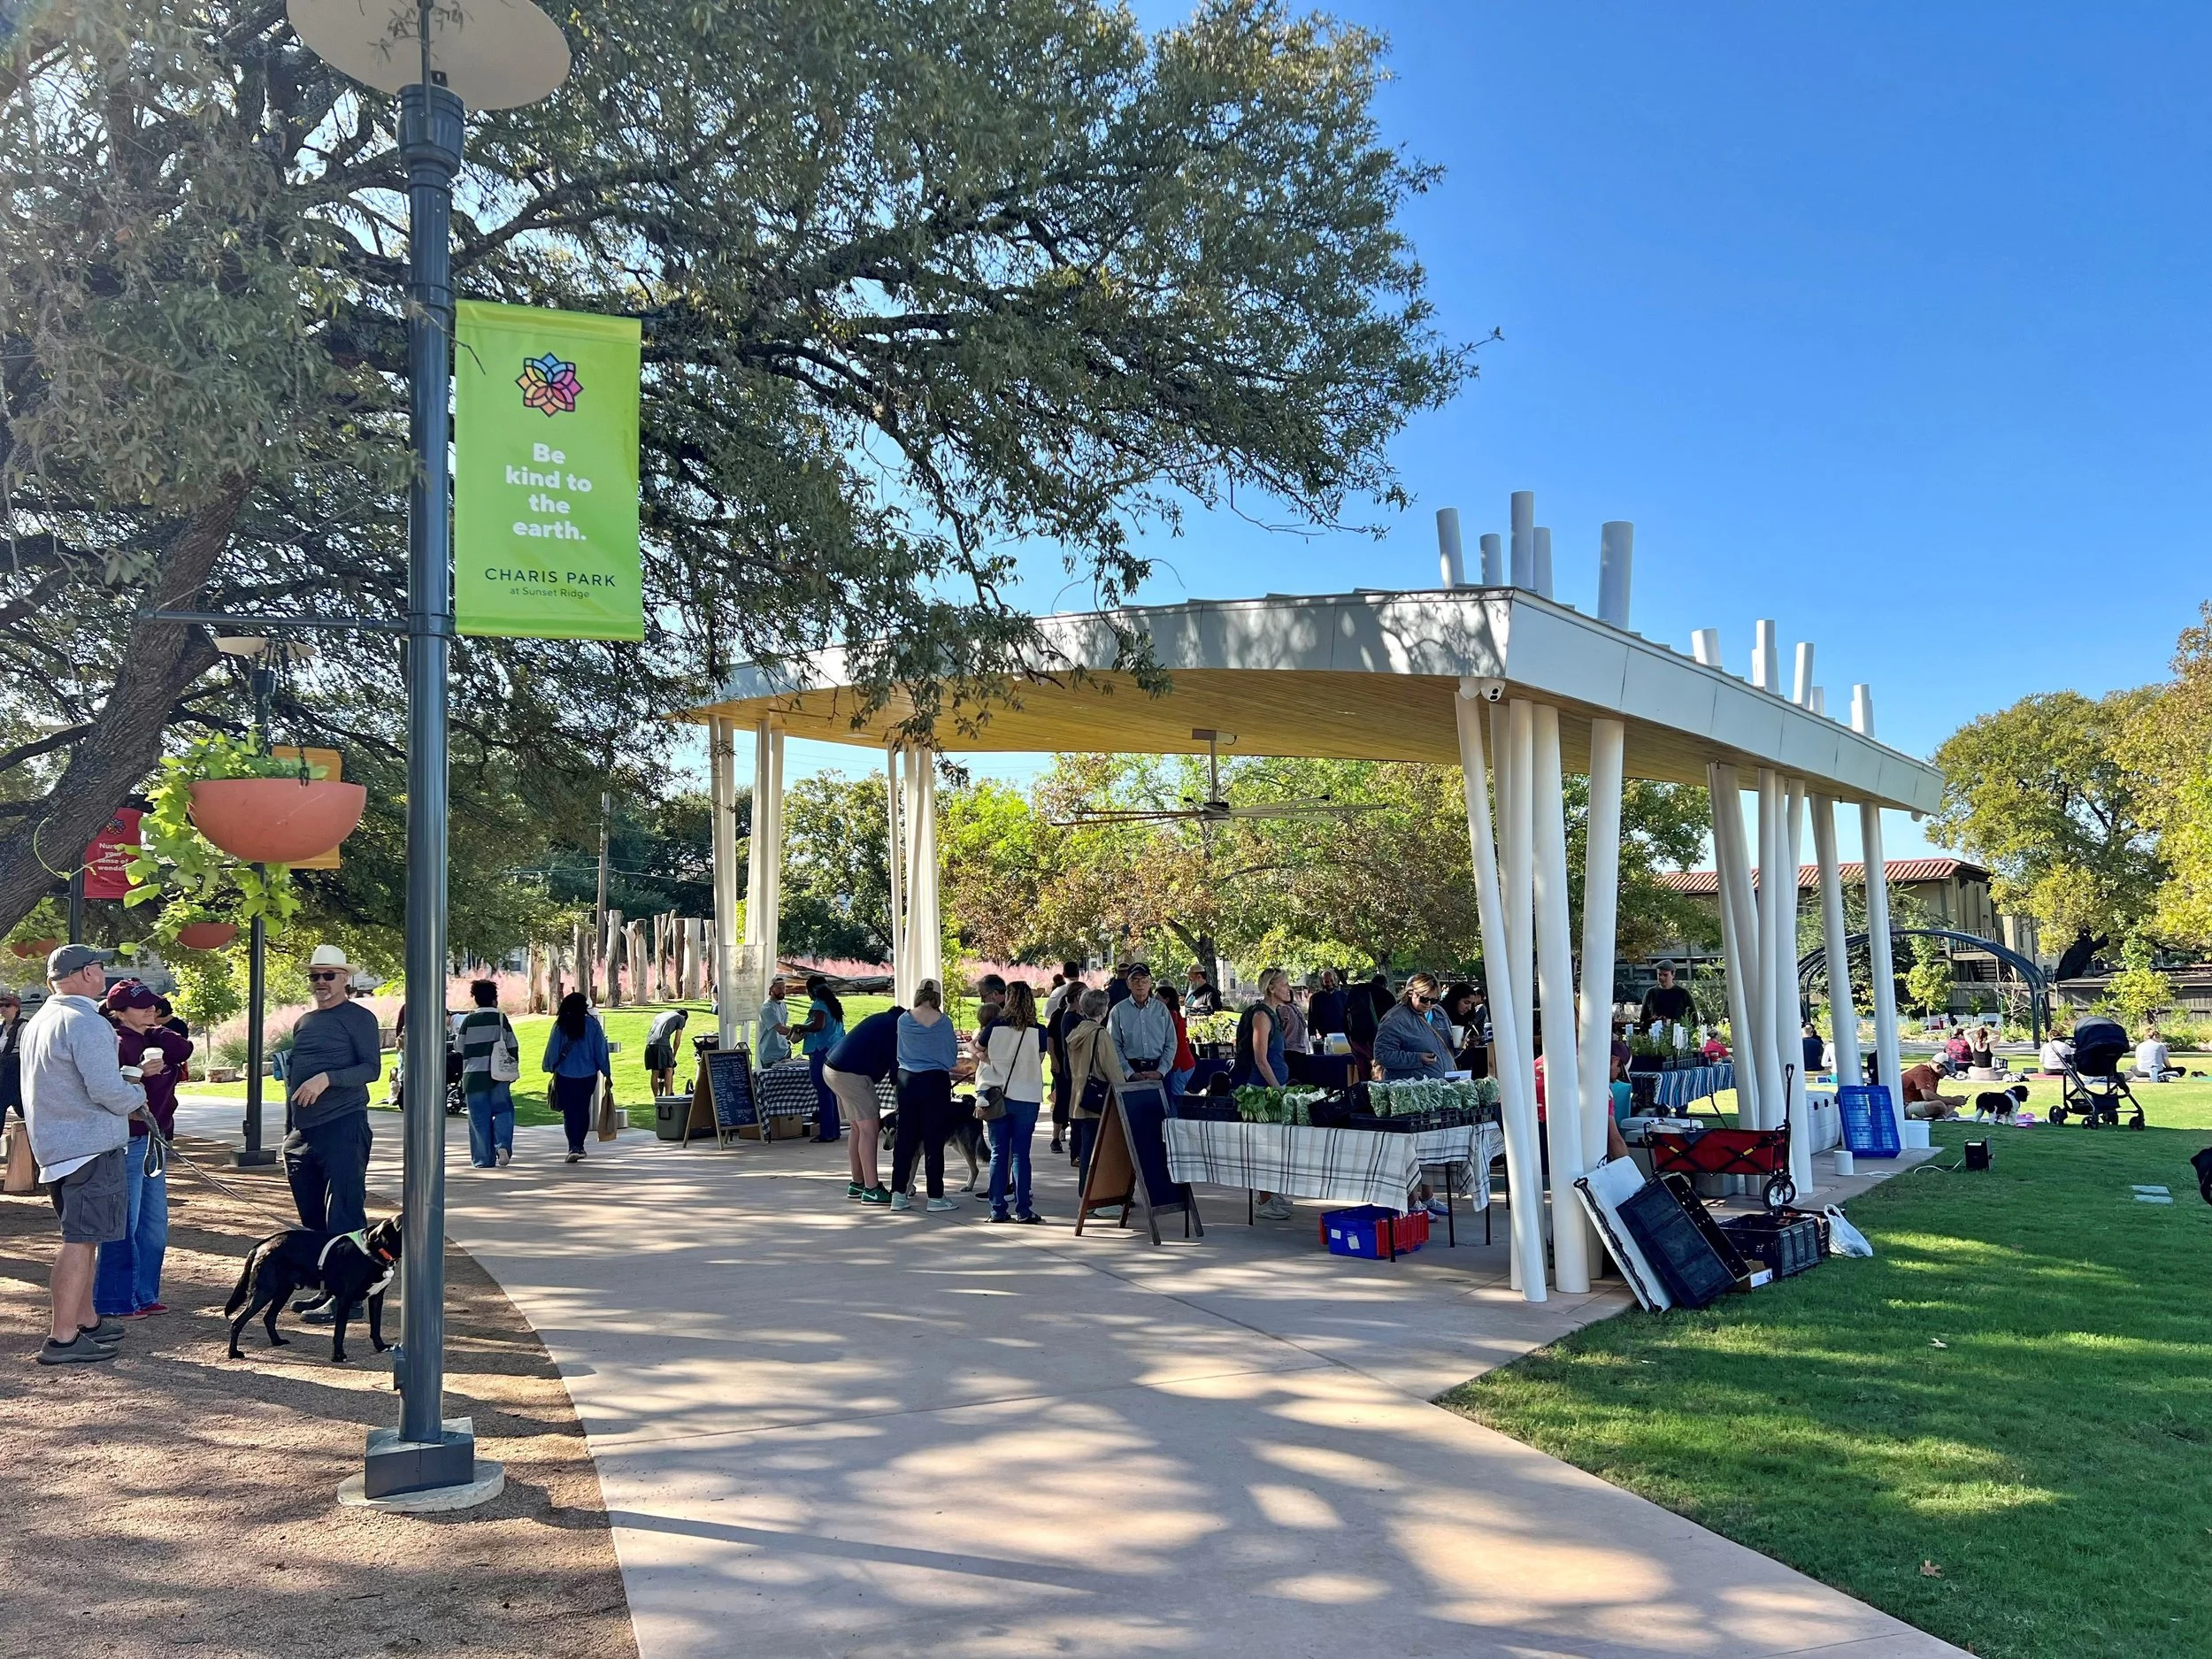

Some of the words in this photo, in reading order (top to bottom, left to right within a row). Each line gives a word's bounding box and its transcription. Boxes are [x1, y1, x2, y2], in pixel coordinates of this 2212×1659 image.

[534, 442, 566, 465] Be
[505, 465, 561, 489] kind
[566, 473, 593, 493] to
[528, 493, 571, 514] the
[512, 520, 588, 541] earth.
[485, 568, 558, 583] CHARIS
[567, 572, 616, 588] PARK
[522, 587, 557, 596] Sunset
[560, 588, 590, 599] Ridge
